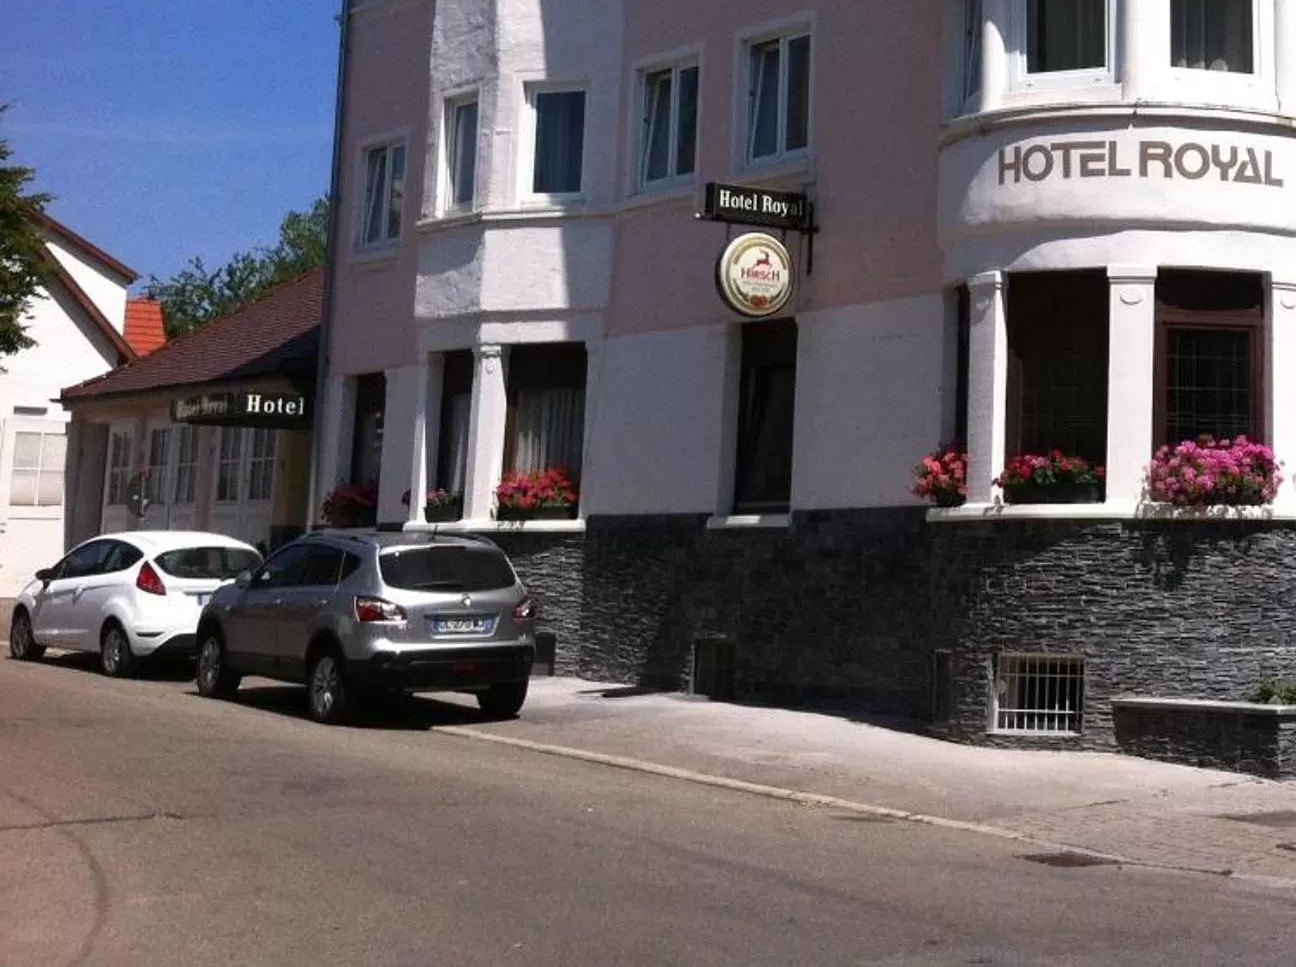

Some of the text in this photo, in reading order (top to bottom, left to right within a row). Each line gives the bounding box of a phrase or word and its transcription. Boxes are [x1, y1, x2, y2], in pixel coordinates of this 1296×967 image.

[999, 140, 1283, 187] HOTEL ROYAL
[719, 190, 757, 211] Hotel
[246, 394, 304, 415] Hotel
